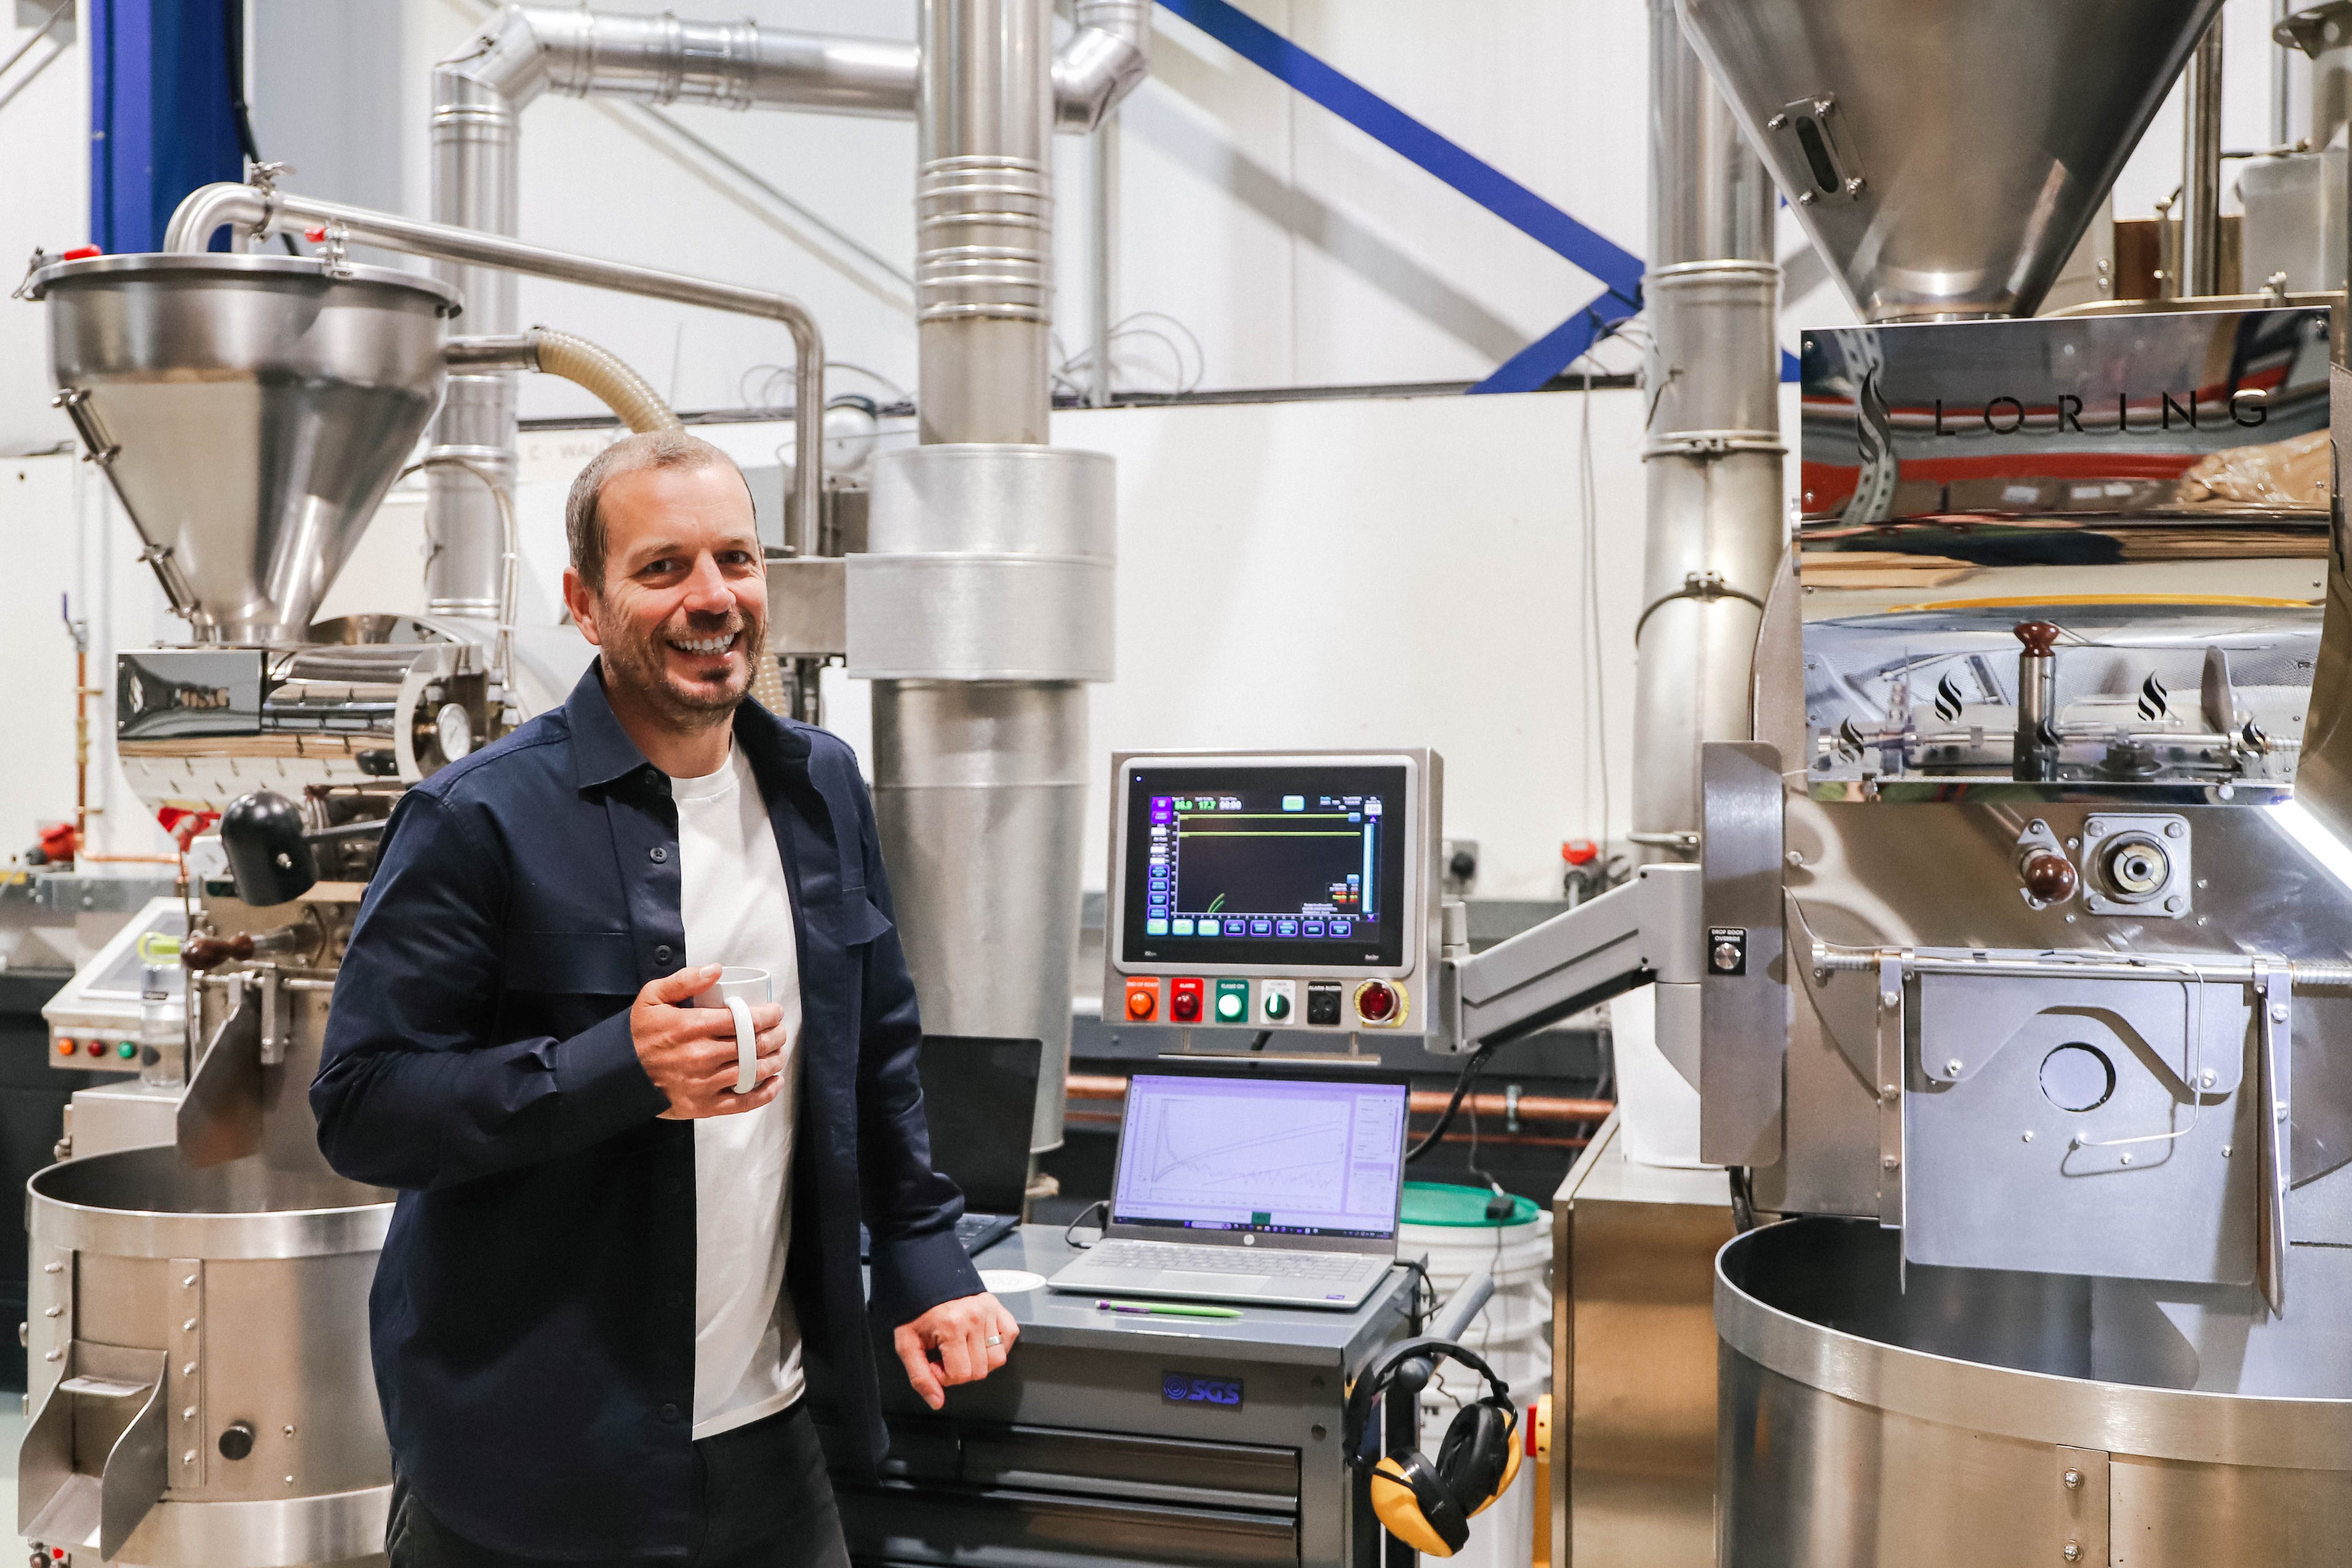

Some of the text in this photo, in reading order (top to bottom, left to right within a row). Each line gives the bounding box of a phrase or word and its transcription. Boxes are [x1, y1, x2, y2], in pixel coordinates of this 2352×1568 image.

[1935, 388, 2268, 436] LORING
[1219, 800, 1242, 810] 00:00
[1187, 1379, 1240, 1405] SGS
